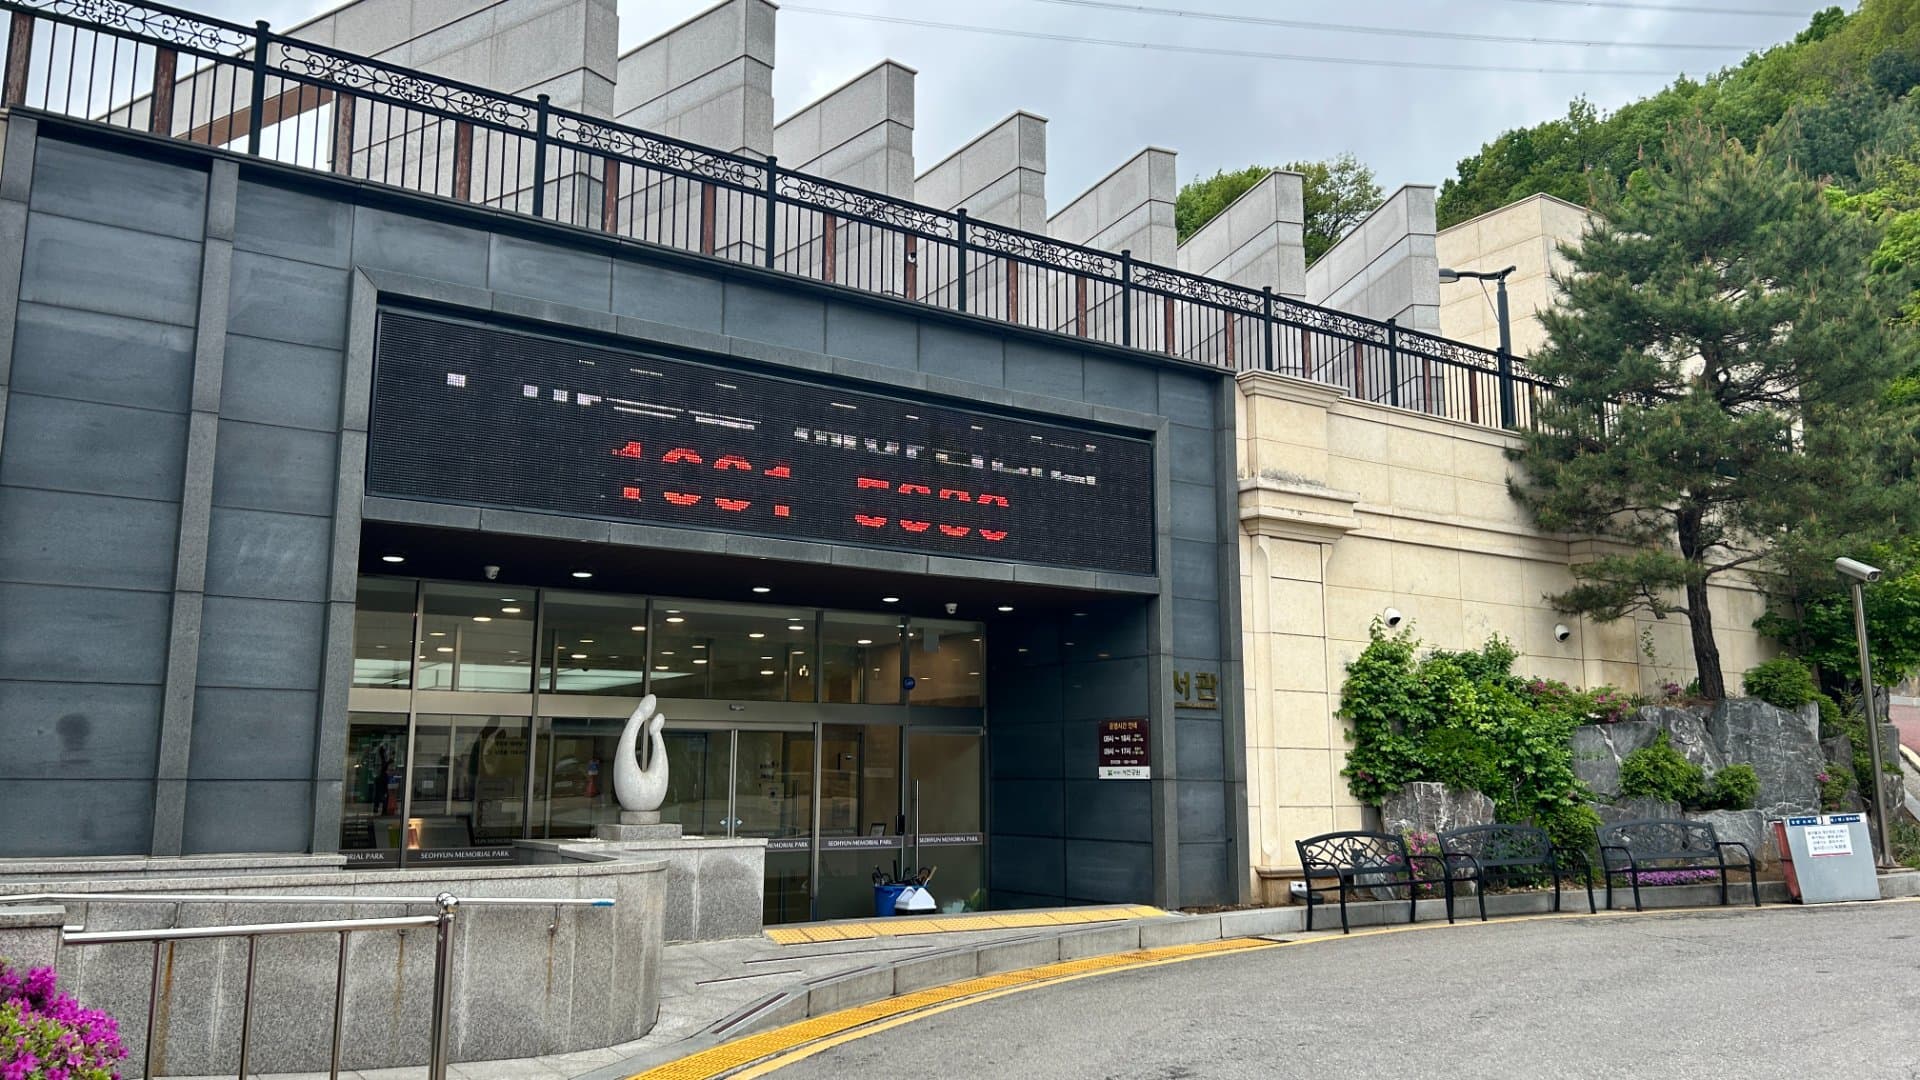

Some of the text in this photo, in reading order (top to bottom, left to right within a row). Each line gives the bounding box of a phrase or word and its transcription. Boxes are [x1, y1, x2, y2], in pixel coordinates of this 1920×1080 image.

[794, 840, 808, 848] PARK
[364, 852, 385, 860] PARK
[420, 849, 509, 859] SEOHYUN MEMORIAL PARK
